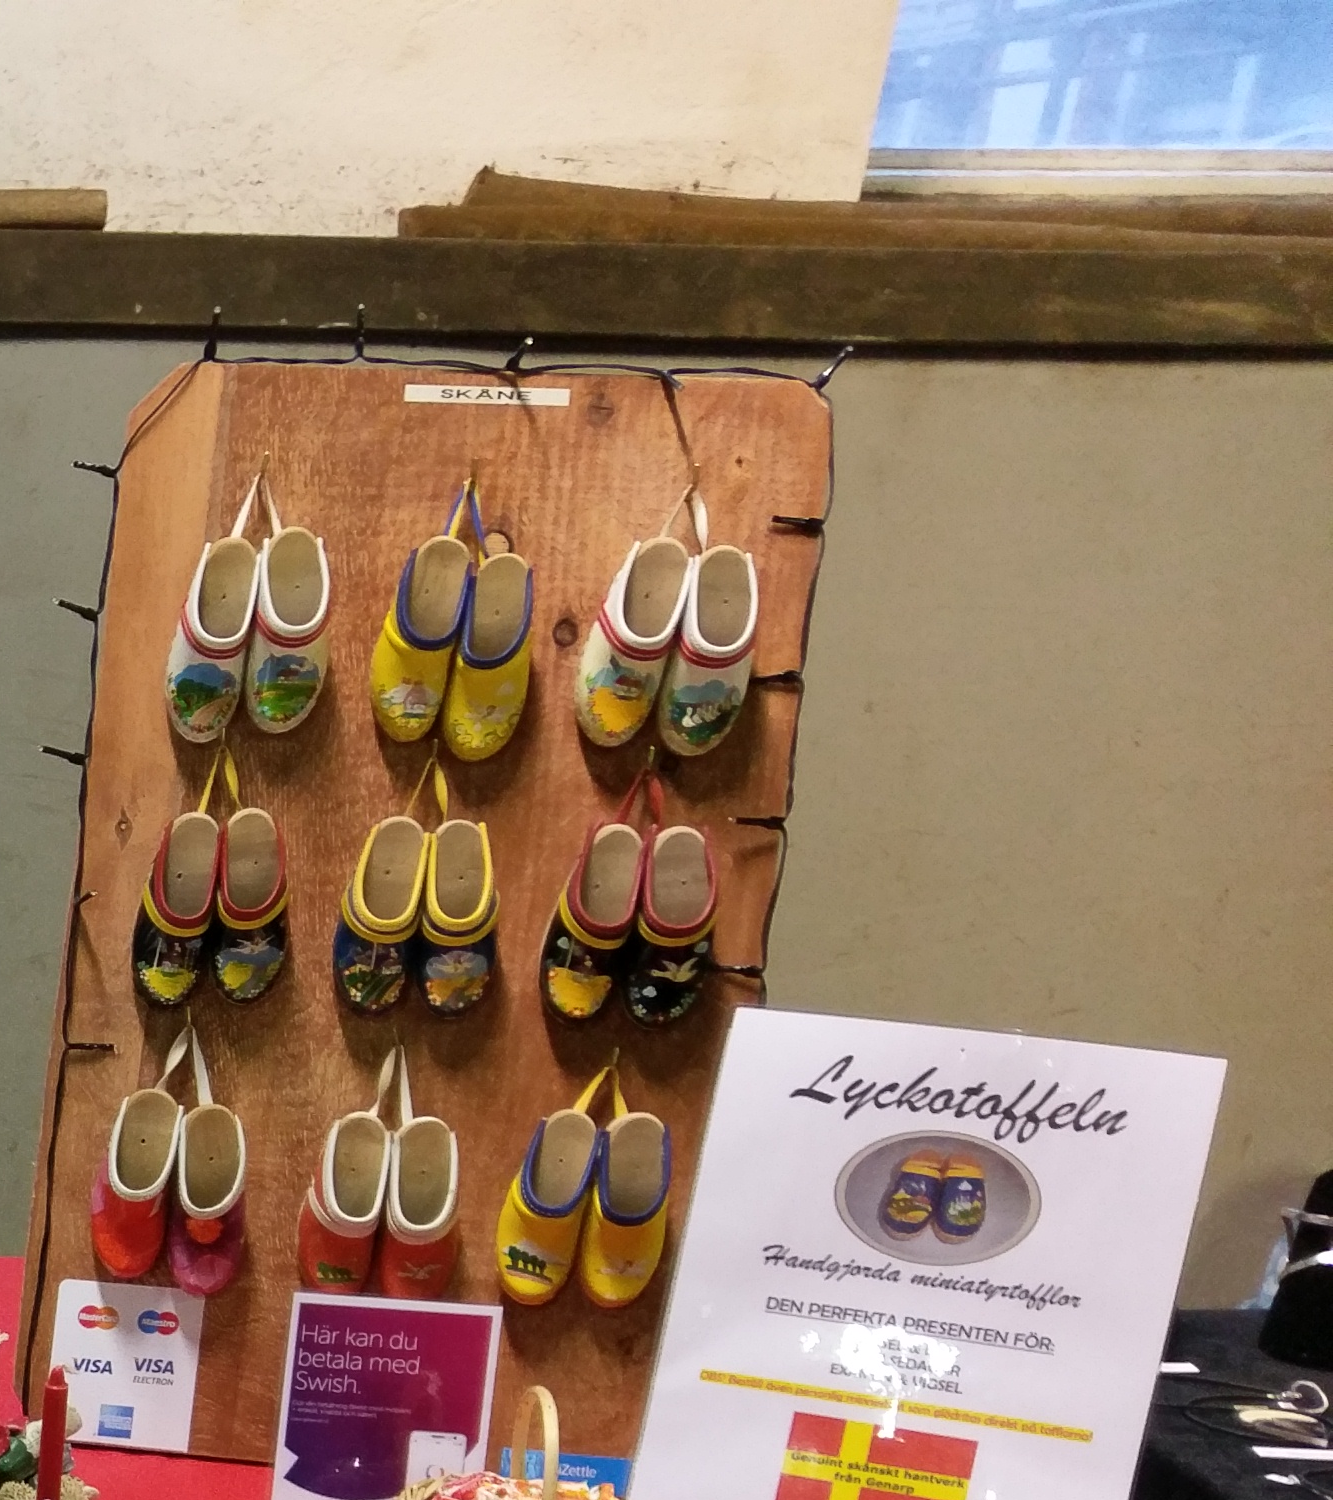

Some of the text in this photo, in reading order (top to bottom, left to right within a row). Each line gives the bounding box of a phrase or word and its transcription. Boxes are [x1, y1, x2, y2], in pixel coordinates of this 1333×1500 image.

[440, 388, 532, 401] SKÅNE
[789, 1055, 1128, 1143] Lyckotoffeln
[762, 1244, 1081, 1311] Handgjorda miniatyrtofflor
[766, 1296, 1055, 1352] DEN PERFEKTA PRESENTEN FÖR:
[301, 1323, 418, 1351] Här kan du
[73, 1357, 113, 1375] VISA
[133, 1357, 174, 1375] VISA
[297, 1348, 421, 1375] betala med
[133, 1375, 174, 1386] ELECTRON
[295, 1371, 361, 1395] Swish.
[834, 1471, 915, 1495] från Genarp
[903, 1469, 966, 1489] hantverk
